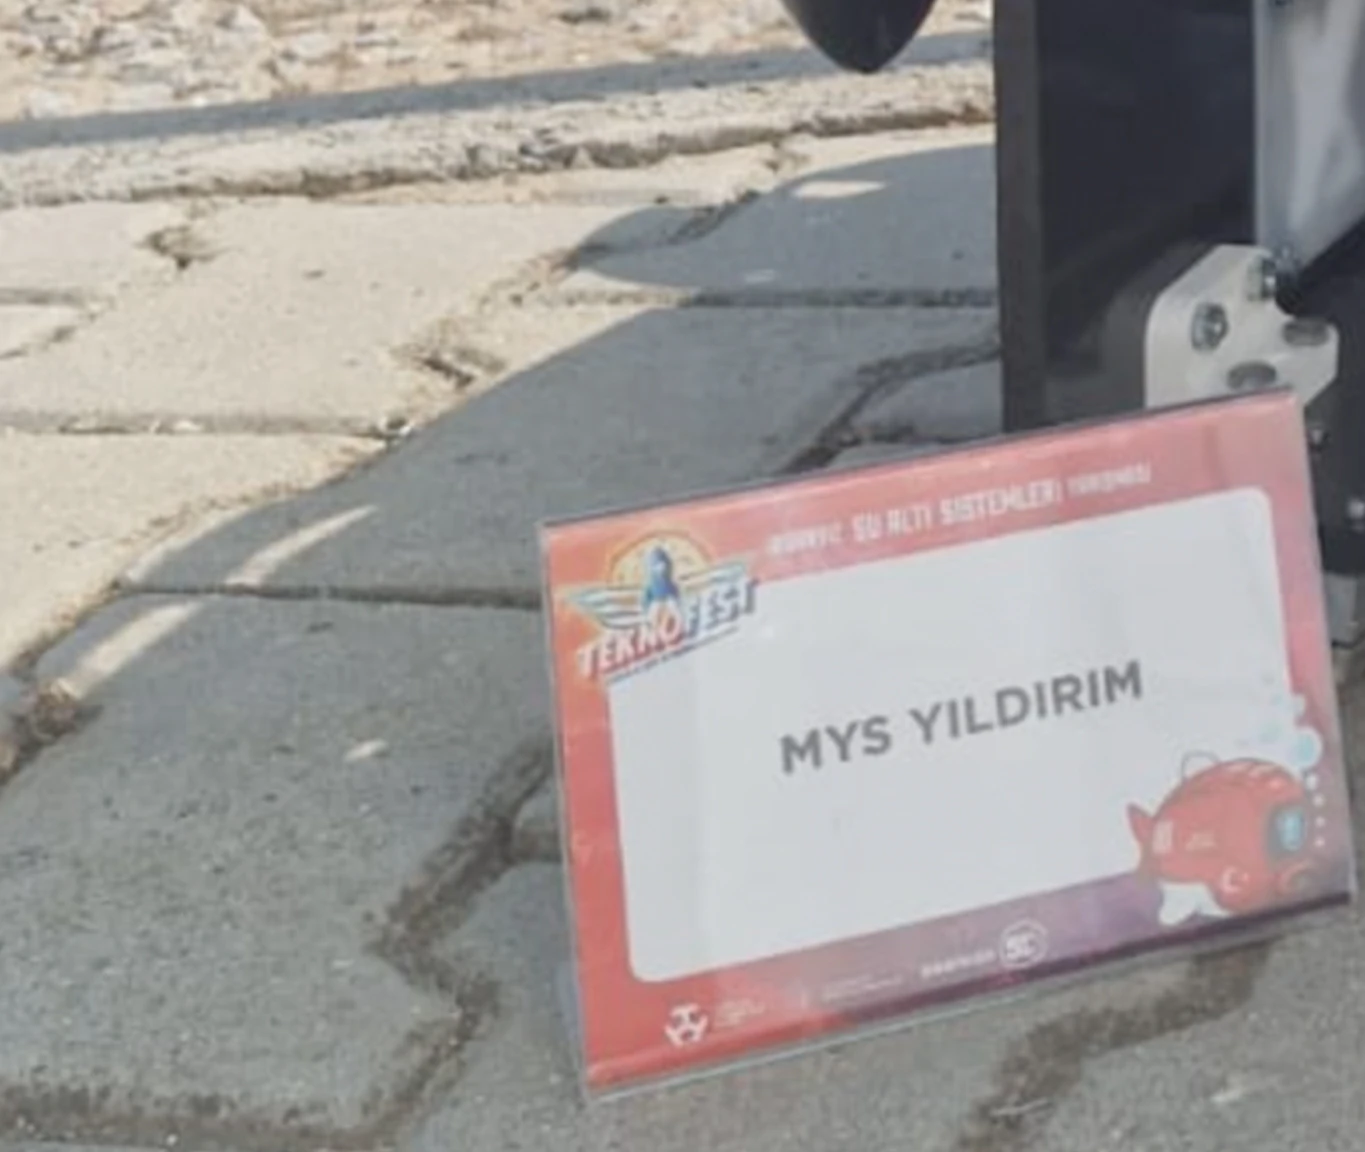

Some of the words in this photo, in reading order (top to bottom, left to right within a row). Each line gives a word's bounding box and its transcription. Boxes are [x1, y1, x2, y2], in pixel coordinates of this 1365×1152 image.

[576, 577, 760, 680] TEKNOFEST
[779, 715, 893, 776] MYS
[907, 659, 1143, 746] YILDIRIM
